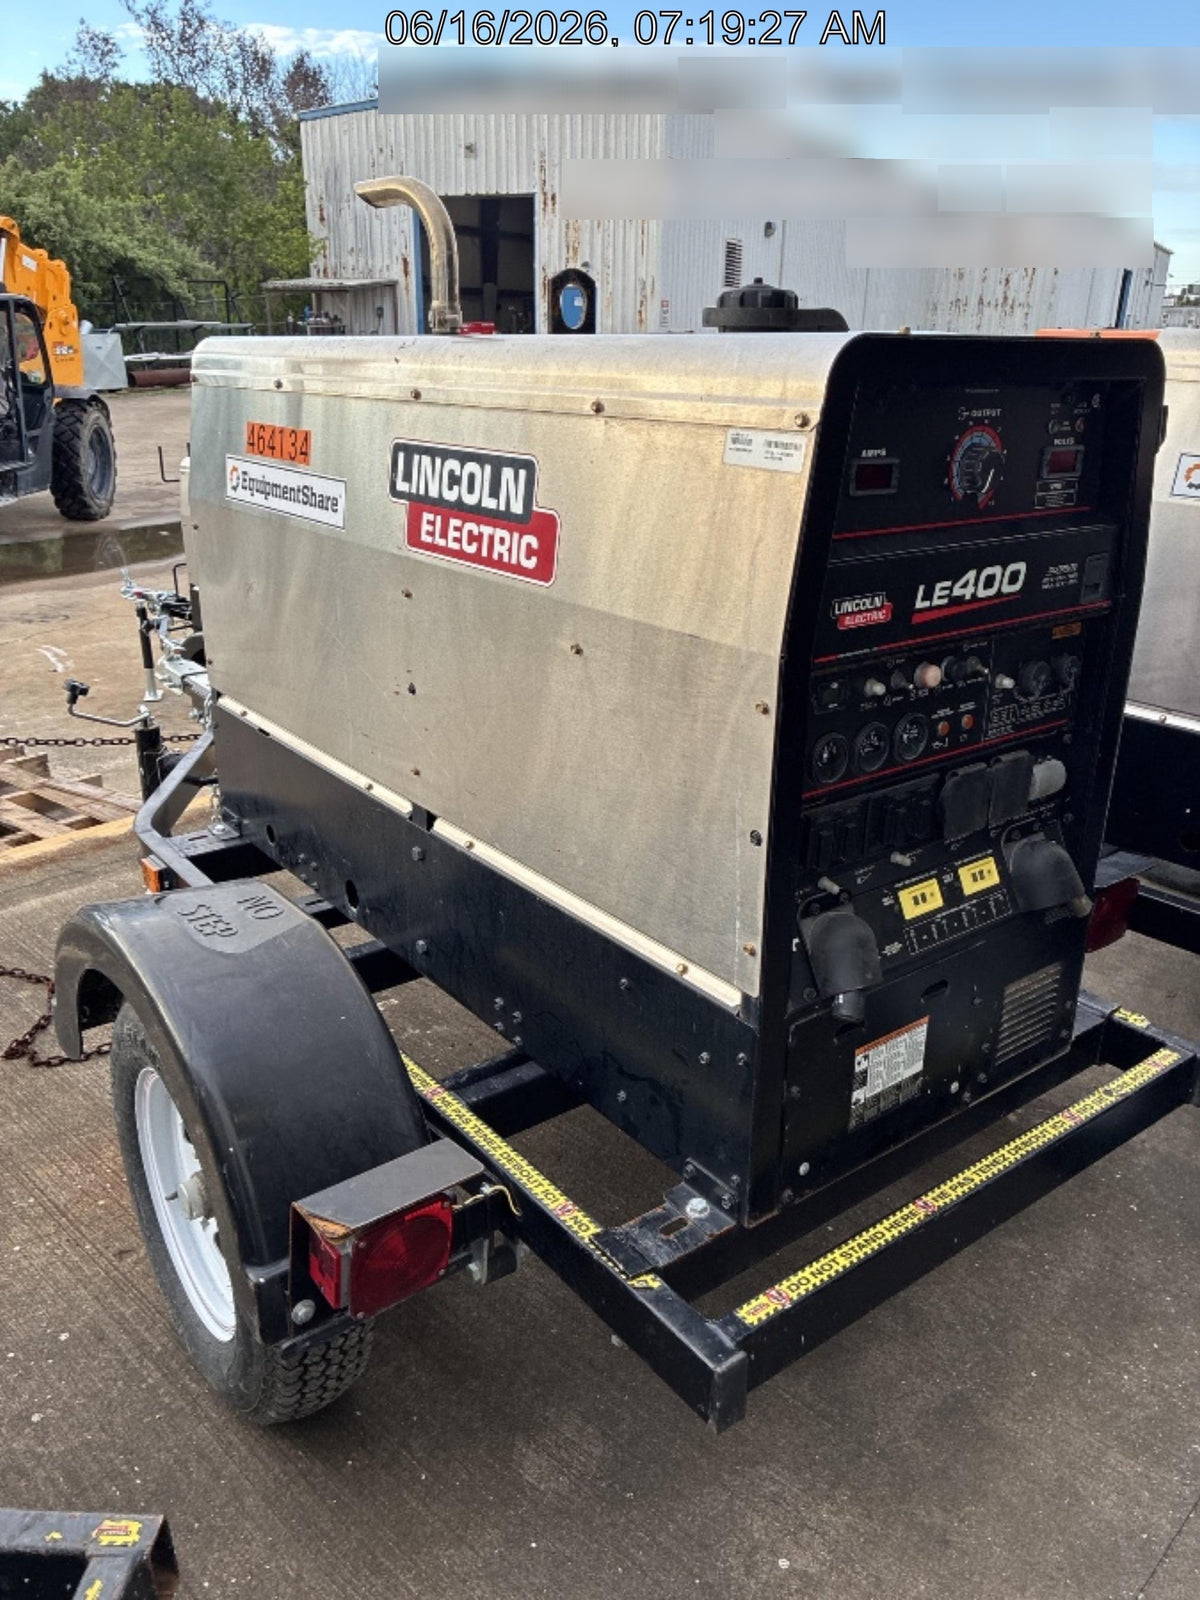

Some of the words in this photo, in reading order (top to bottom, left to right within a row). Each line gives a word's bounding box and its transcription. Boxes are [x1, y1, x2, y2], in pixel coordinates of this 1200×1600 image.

[971, 408, 1002, 417] OUTPUT
[246, 424, 310, 463] 464134
[861, 448, 887, 458] AMPS
[241, 470, 339, 513] EquipmentShare
[395, 451, 526, 514] LINCOLN
[420, 512, 538, 569] ELECTRIC
[914, 561, 1027, 609] LE400
[835, 595, 883, 615] LINCOLN
[844, 609, 887, 626] ELECTRIC
[178, 904, 238, 938] STEP
[237, 895, 284, 921] NO
[470, 1123, 502, 1153] TENEZ
[500, 1151, 544, 1189] DEBOUT
[949, 1176, 976, 1193] PAS
[972, 1154, 1008, 1178] TENEZ
[1007, 1128, 1050, 1157] DEBOUT
[569, 1214, 590, 1233] NO
[787, 1276, 810, 1294] DO
[811, 1258, 841, 1280] NOT
[840, 1230, 886, 1260] STAND
[884, 1208, 920, 1232] HERE
